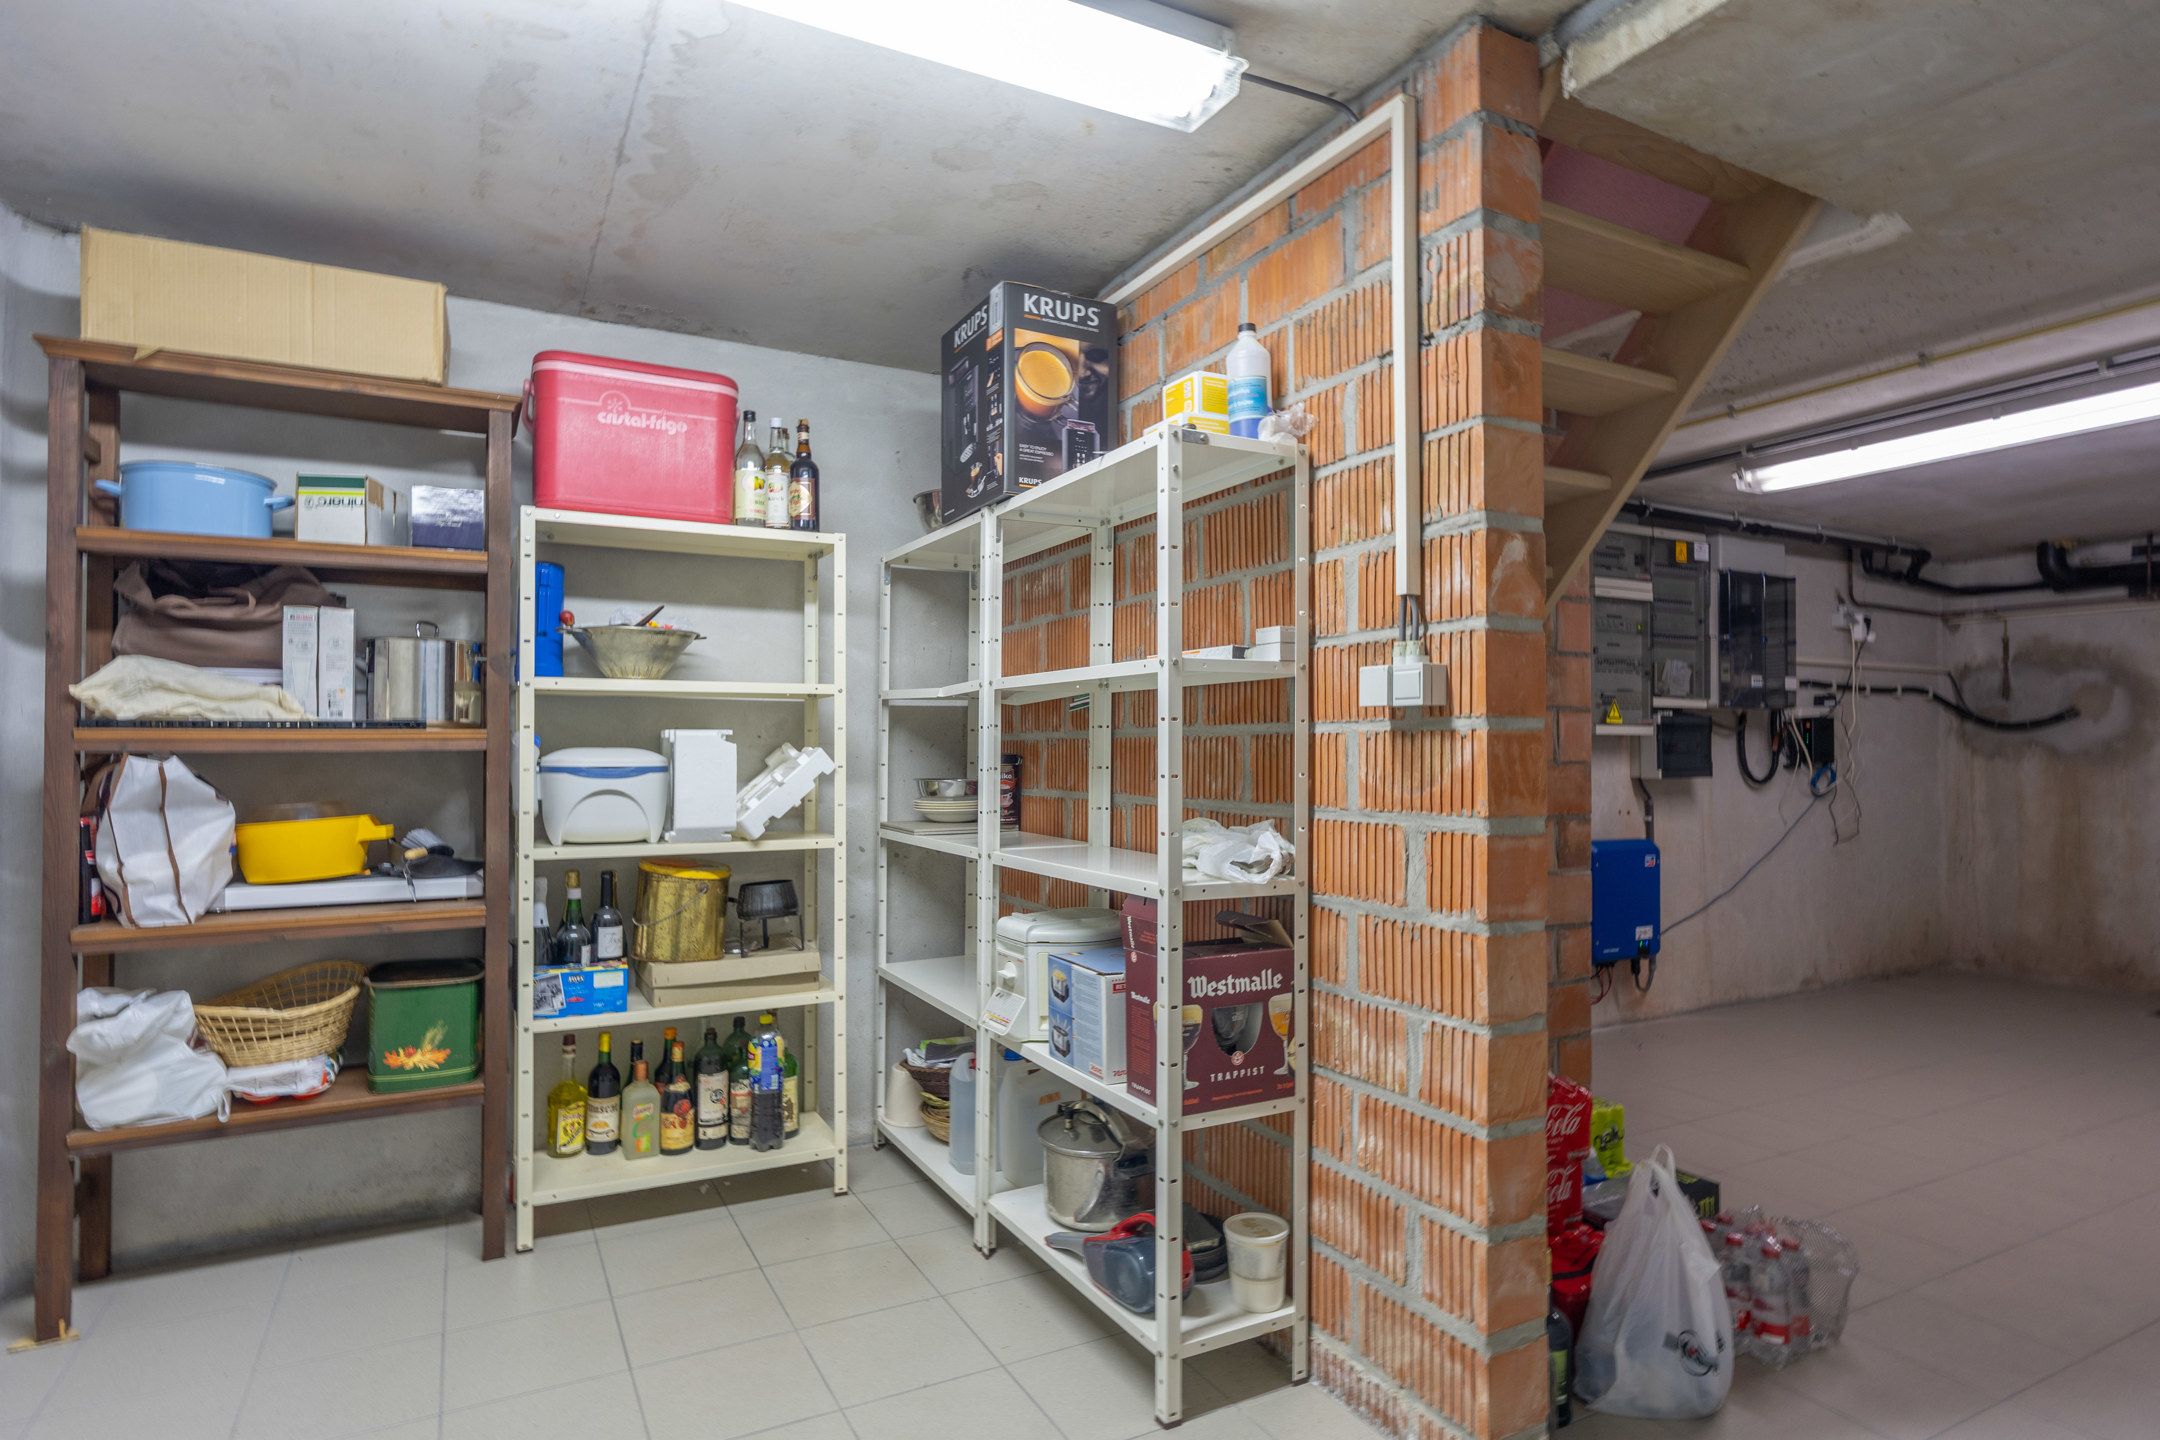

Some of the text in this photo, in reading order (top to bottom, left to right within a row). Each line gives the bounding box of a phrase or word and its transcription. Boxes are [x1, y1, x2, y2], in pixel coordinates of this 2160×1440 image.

[1024, 292, 1100, 327] KRUPS
[954, 305, 988, 348] KRUPS
[1019, 477, 1042, 485] KRUPS
[1187, 968, 1283, 998] Westmalle
[1210, 1066, 1264, 1082] TRAPPIST
